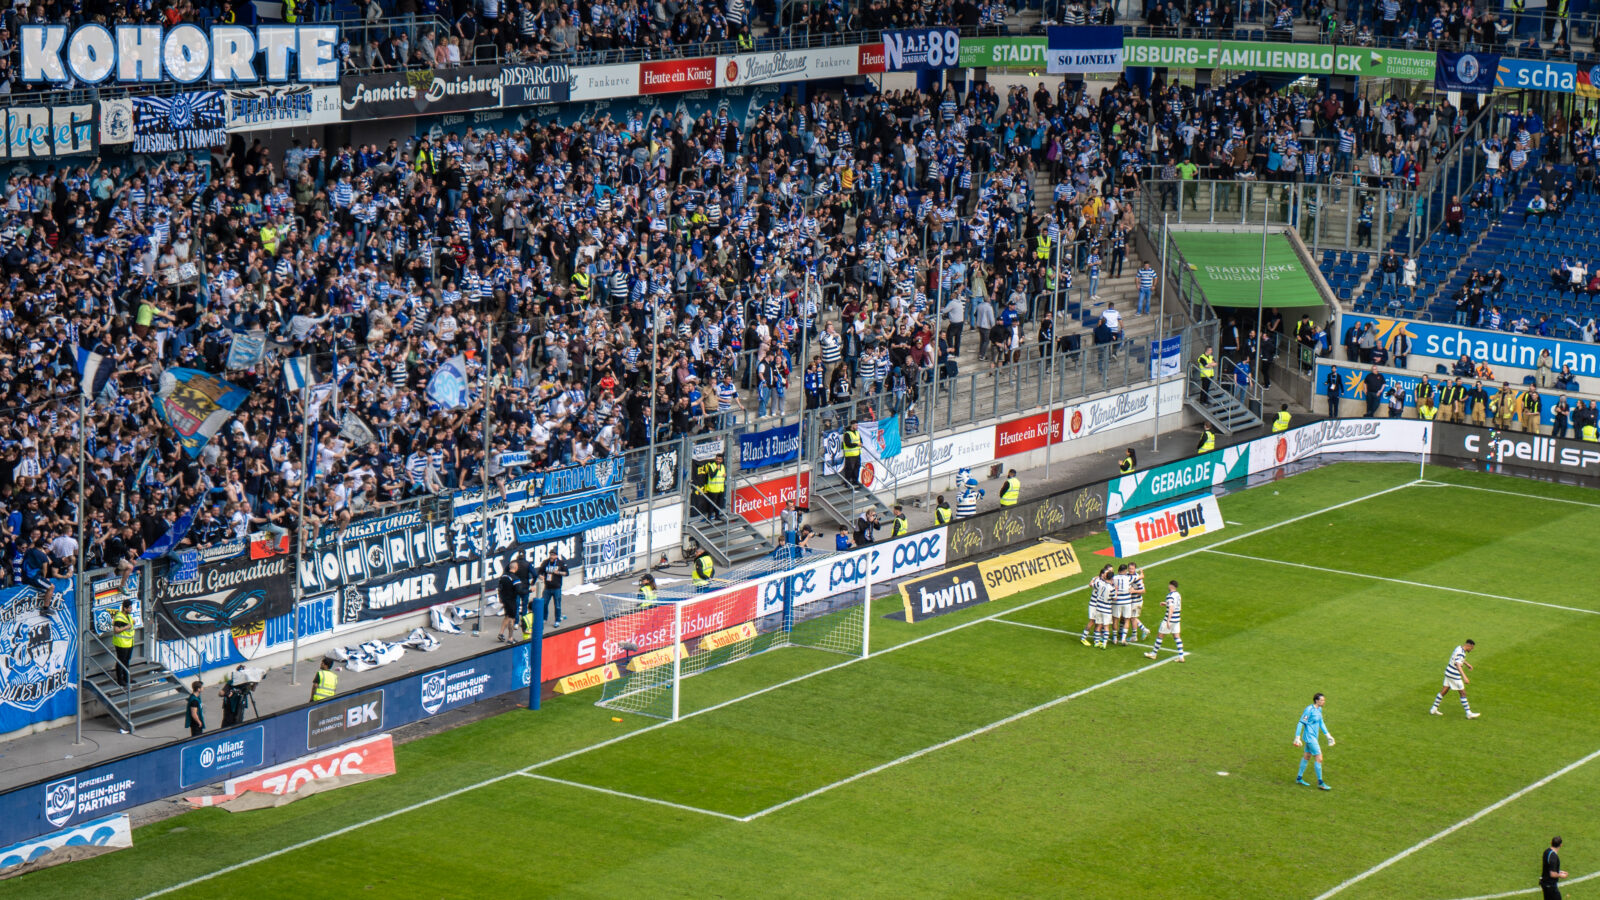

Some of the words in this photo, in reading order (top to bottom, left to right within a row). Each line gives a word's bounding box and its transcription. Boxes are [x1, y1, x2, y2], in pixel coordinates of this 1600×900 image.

[20, 24, 340, 83] KOHORTE
[862, 51, 885, 66] Heute
[927, 30, 959, 66] 89
[959, 54, 976, 63] BURG
[960, 45, 985, 54] TWERKE
[1122, 45, 1362, 71] UISBURG-FAMILIENBLOCK
[744, 57, 773, 80] König
[772, 51, 807, 73] Pilsener
[815, 57, 851, 68] Fankurve
[1058, 55, 1072, 65] SO
[1075, 54, 1117, 65] LONELY
[1387, 56, 1436, 68] STADTWERK
[644, 71, 670, 85] Heute
[671, 70, 685, 82] ein
[686, 67, 713, 84] König
[1386, 65, 1429, 76] DUISBURG
[425, 75, 499, 102] Duisburg
[588, 76, 631, 88] Fankurve
[523, 86, 550, 101] MCMII
[133, 133, 177, 153] DUISBURG
[1209, 272, 1280, 281] DUISBURG
[1000, 431, 1023, 446] Heute
[1023, 425, 1036, 440] ein
[1294, 428, 1323, 455] König
[1320, 417, 1381, 442] Pilsener
[742, 440, 764, 462] Block
[957, 441, 991, 455] Fankurve
[543, 464, 597, 496] METROPOL
[1151, 461, 1210, 495] GEBAG.DE
[514, 495, 619, 537] WEDAUSTADION
[734, 498, 762, 515] Heute
[585, 518, 635, 543] RUHRPOTT
[636, 521, 678, 539] Fakurve
[1135, 503, 1206, 538] trinkgut
[300, 525, 448, 588] KOHORTE
[892, 533, 940, 573] pape
[207, 558, 286, 592] Generation
[587, 558, 629, 580] KANAKEN
[829, 549, 879, 591] pape
[986, 548, 1075, 588] SPORTWETTEN
[368, 573, 438, 609] IMMER
[444, 555, 505, 592] ALLES
[764, 568, 816, 611] pape
[1117, 578, 1124, 590] 11
[920, 576, 977, 614] bwin
[265, 598, 335, 649] DUISBURG
[601, 626, 666, 660] Spkasse
[670, 611, 724, 639] Duisburg
[713, 632, 740, 648] Sinalco
[639, 653, 671, 671] Sinalco
[446, 674, 491, 693] RHEIN-RUHR-
[447, 668, 475, 681] OFFIZIELLER
[567, 673, 600, 691] Sinalco
[446, 684, 484, 704] PARTNER
[346, 700, 378, 728] BK
[216, 741, 244, 755] Allianz
[217, 754, 230, 762] Wirz
[231, 749, 244, 758] OHG
[78, 773, 114, 789] OFFIZIELLER
[78, 779, 135, 803] RHEIN-RUHR-
[78, 790, 126, 814] PARTNER
